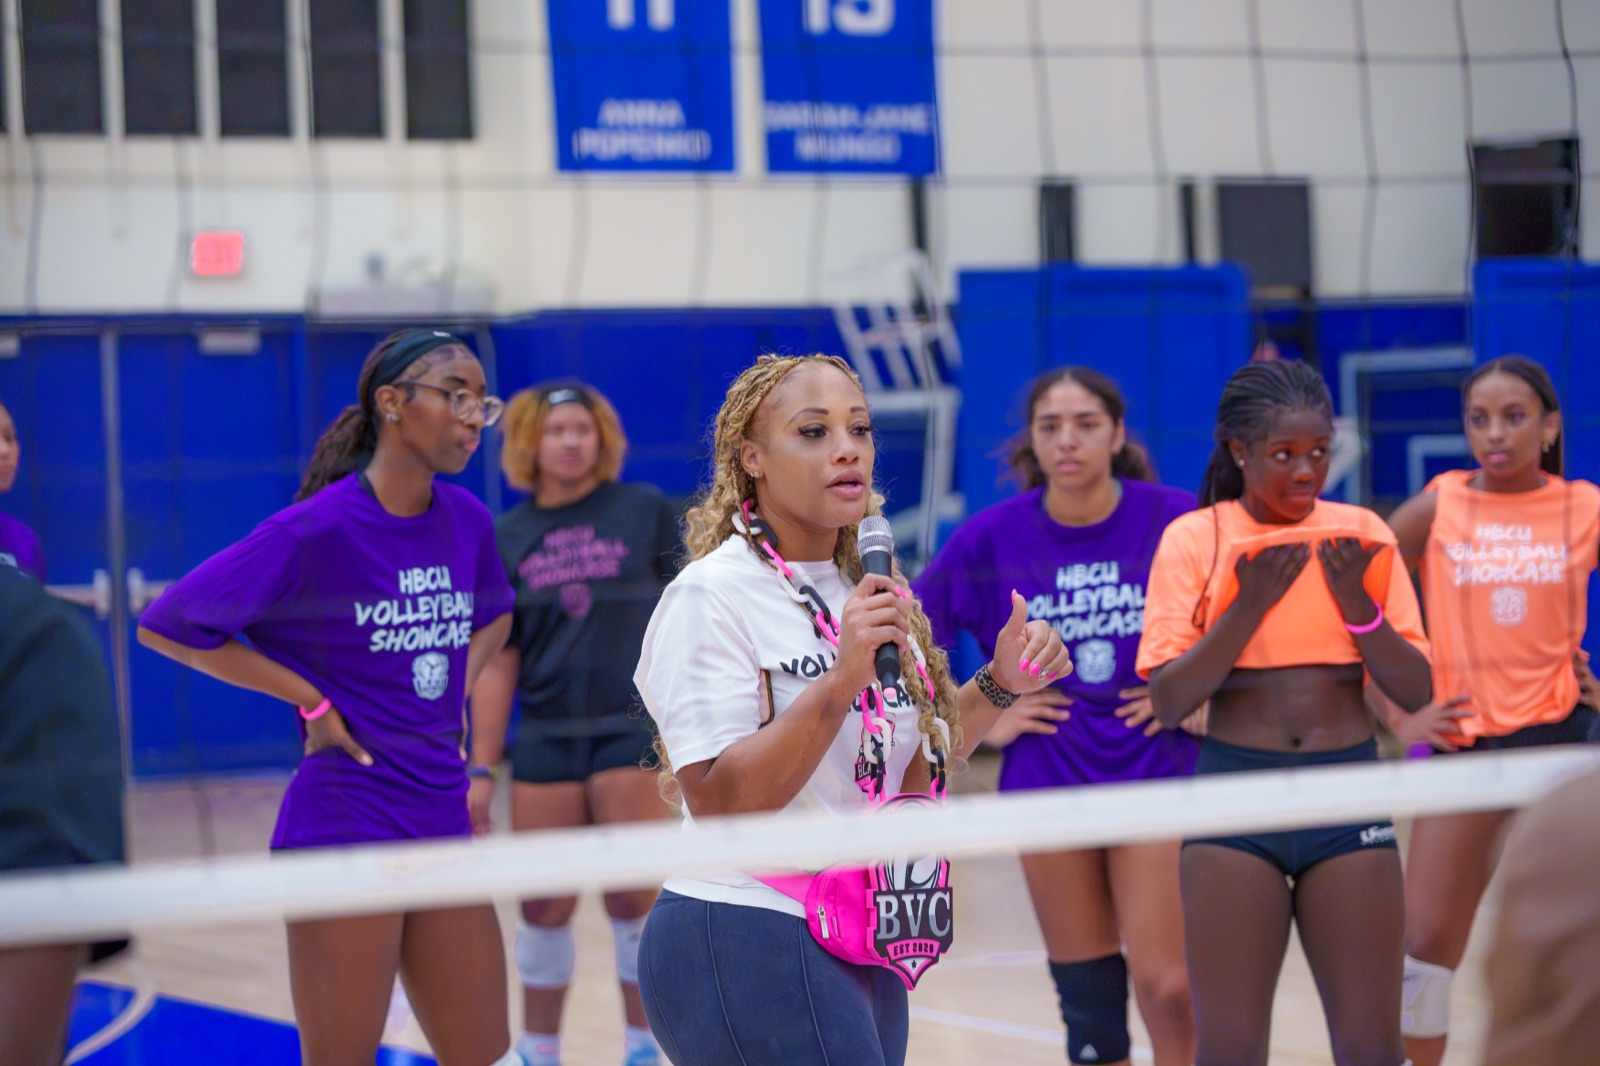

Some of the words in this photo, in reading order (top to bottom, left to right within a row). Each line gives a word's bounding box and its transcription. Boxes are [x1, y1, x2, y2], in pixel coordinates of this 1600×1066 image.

[399, 565, 452, 595] HBCU
[1056, 561, 1119, 590] HBCU
[876, 891, 951, 940] BVC
[893, 943, 910, 957] EST
[912, 942, 934, 954] 2020
